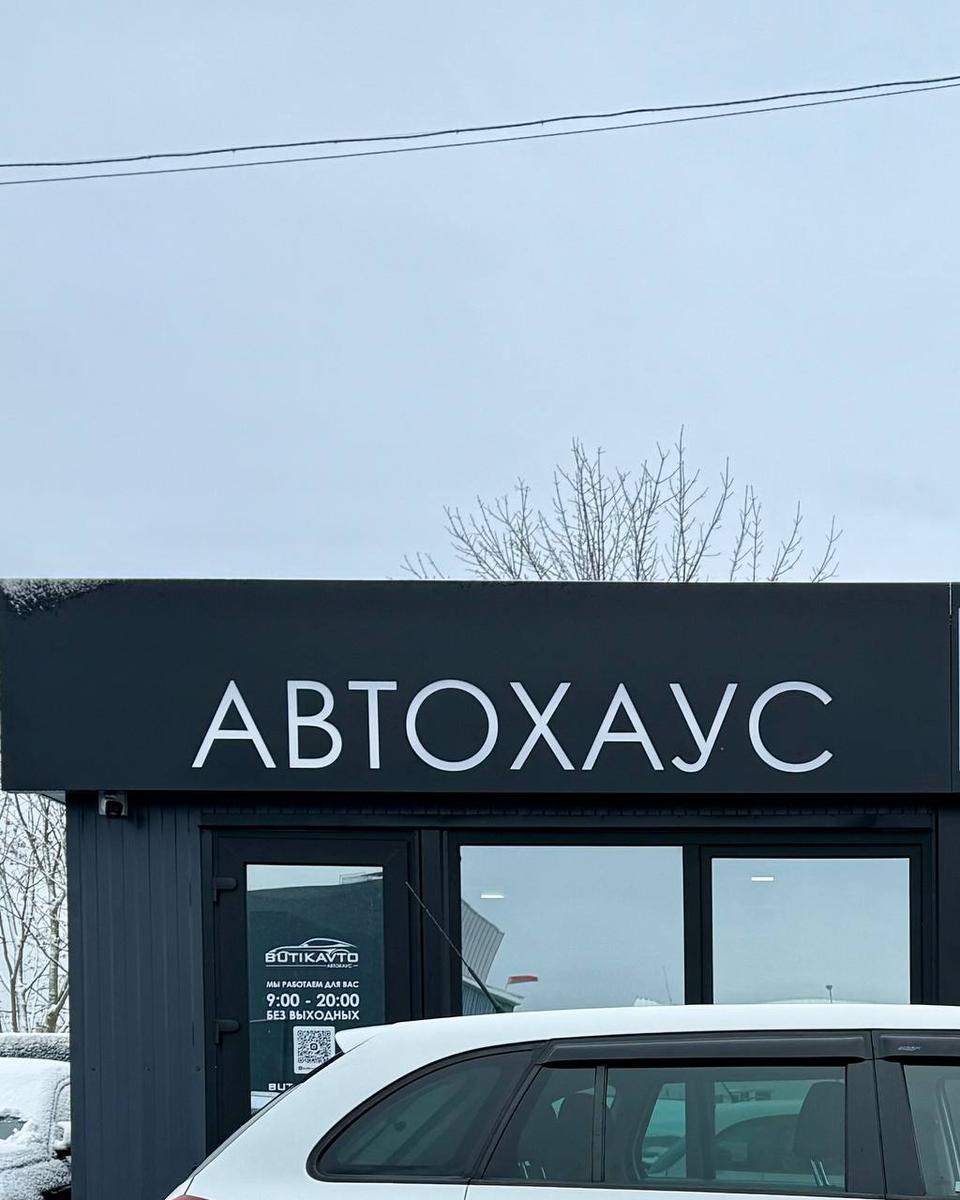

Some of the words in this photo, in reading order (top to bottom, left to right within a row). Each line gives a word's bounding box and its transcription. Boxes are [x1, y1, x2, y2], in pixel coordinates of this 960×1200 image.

[192, 679, 834, 773] АВТОХАУС
[265, 951, 359, 963] BUTIKAVTO
[324, 981, 340, 989] ДЛЯ
[266, 993, 300, 1007] 9:00
[316, 993, 360, 1007] 20:00
[266, 1010, 286, 1020] БЕЗ
[289, 1010, 360, 1021] ВЫХОДНЫХ
